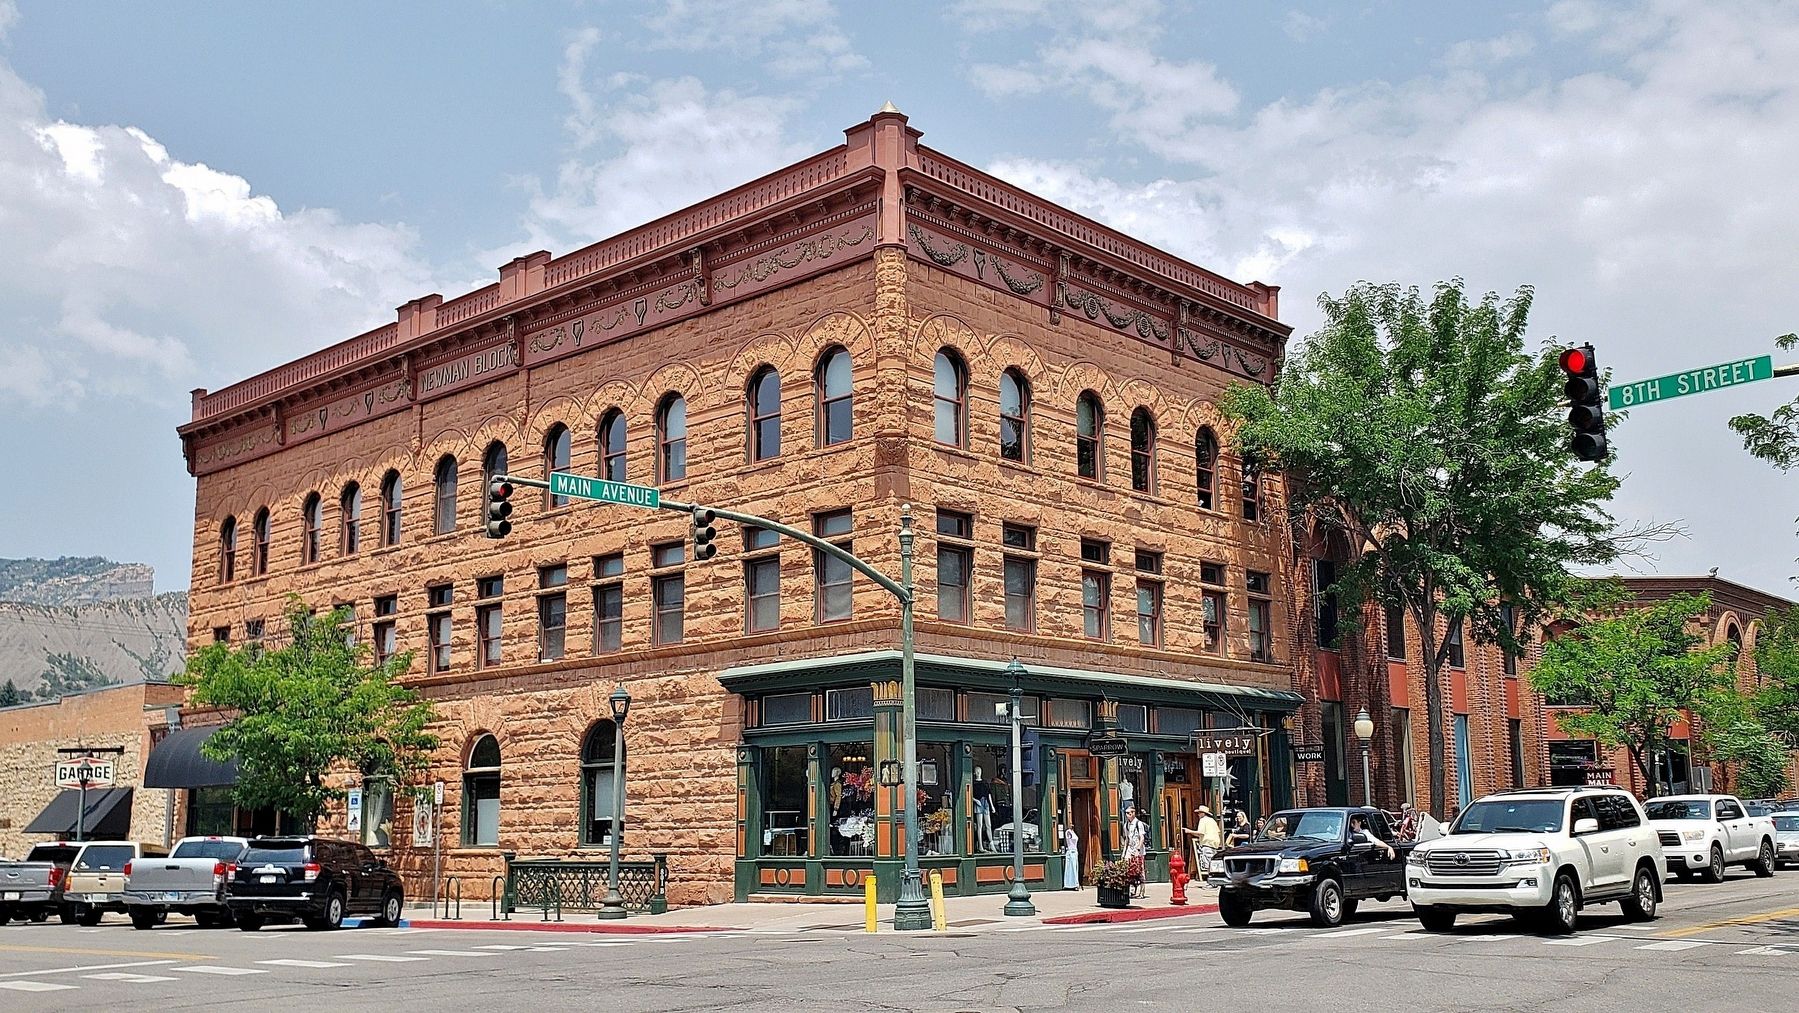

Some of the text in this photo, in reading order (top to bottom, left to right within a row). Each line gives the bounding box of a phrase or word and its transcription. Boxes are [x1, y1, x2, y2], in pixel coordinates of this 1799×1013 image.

[420, 344, 514, 394] NEWMAN BLOCK
[1622, 359, 1757, 406] 8TH STREET
[557, 475, 653, 506] MAIN AVENUE
[1198, 737, 1251, 750] lively
[1118, 756, 1143, 769] ively
[1297, 752, 1322, 760] WORK
[1586, 771, 1612, 780] MAIN
